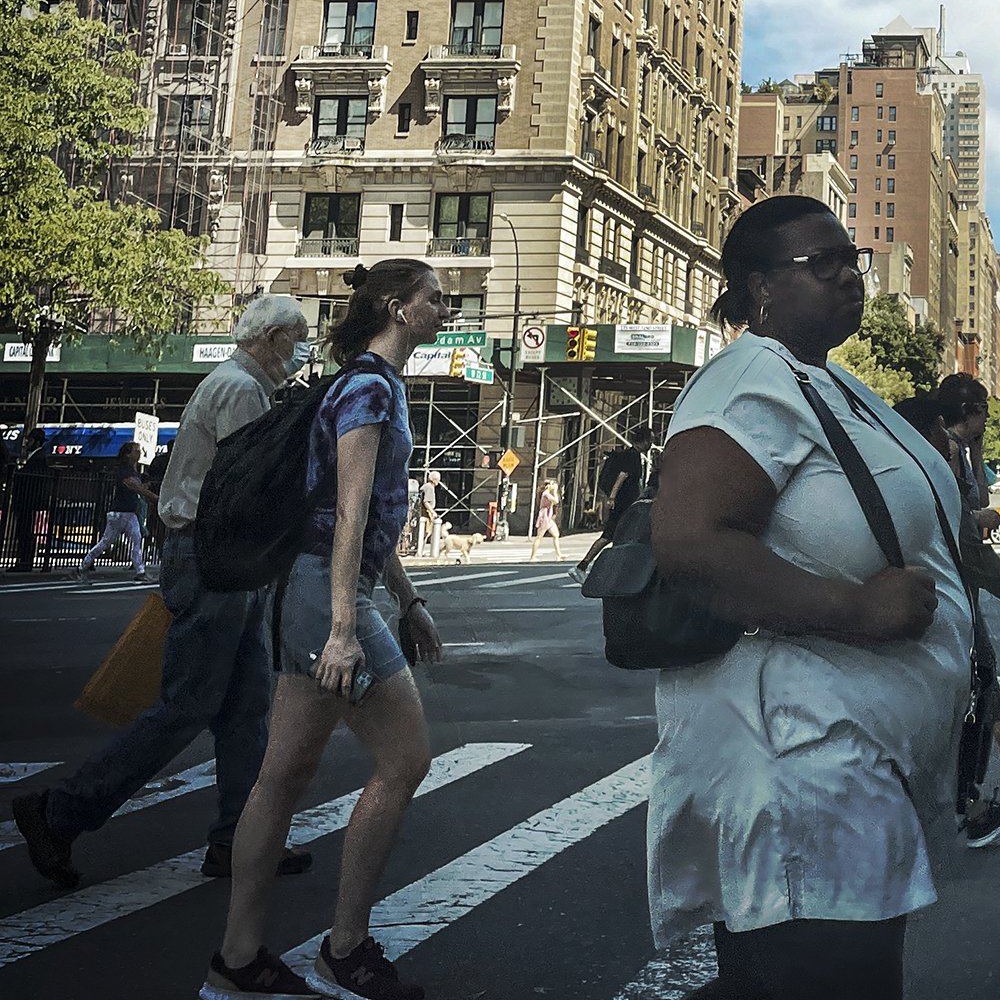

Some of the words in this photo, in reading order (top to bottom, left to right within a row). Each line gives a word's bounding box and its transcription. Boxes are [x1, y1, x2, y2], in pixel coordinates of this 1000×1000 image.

[439, 336, 464, 345] dam
[467, 334, 482, 344] Av
[199, 346, 235, 359] HAAGEN-D
[137, 417, 156, 432] BUSES
[138, 431, 154, 443] ONLY
